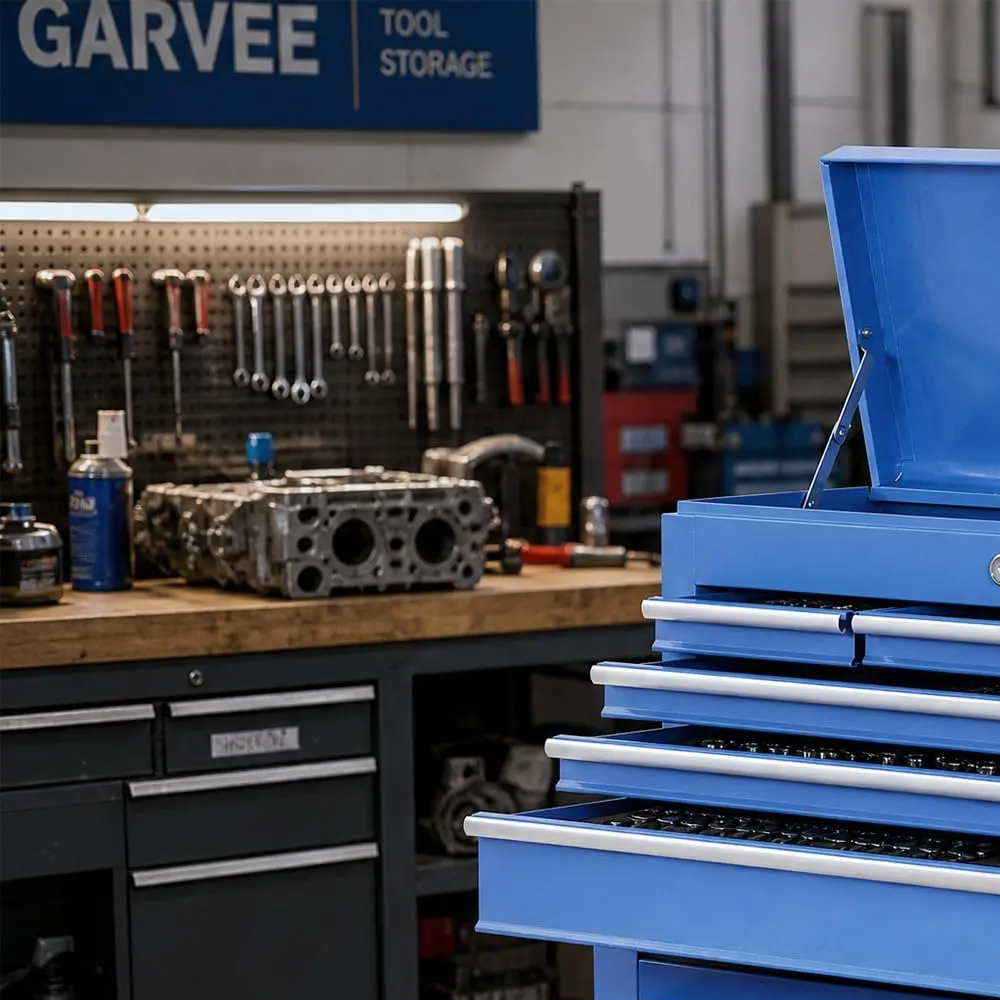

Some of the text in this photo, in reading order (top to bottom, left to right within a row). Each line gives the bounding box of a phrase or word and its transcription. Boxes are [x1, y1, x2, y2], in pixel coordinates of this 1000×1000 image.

[18, 0, 319, 75] GARVEE
[379, 8, 449, 38] TOOL
[380, 49, 494, 79] STORAGE
